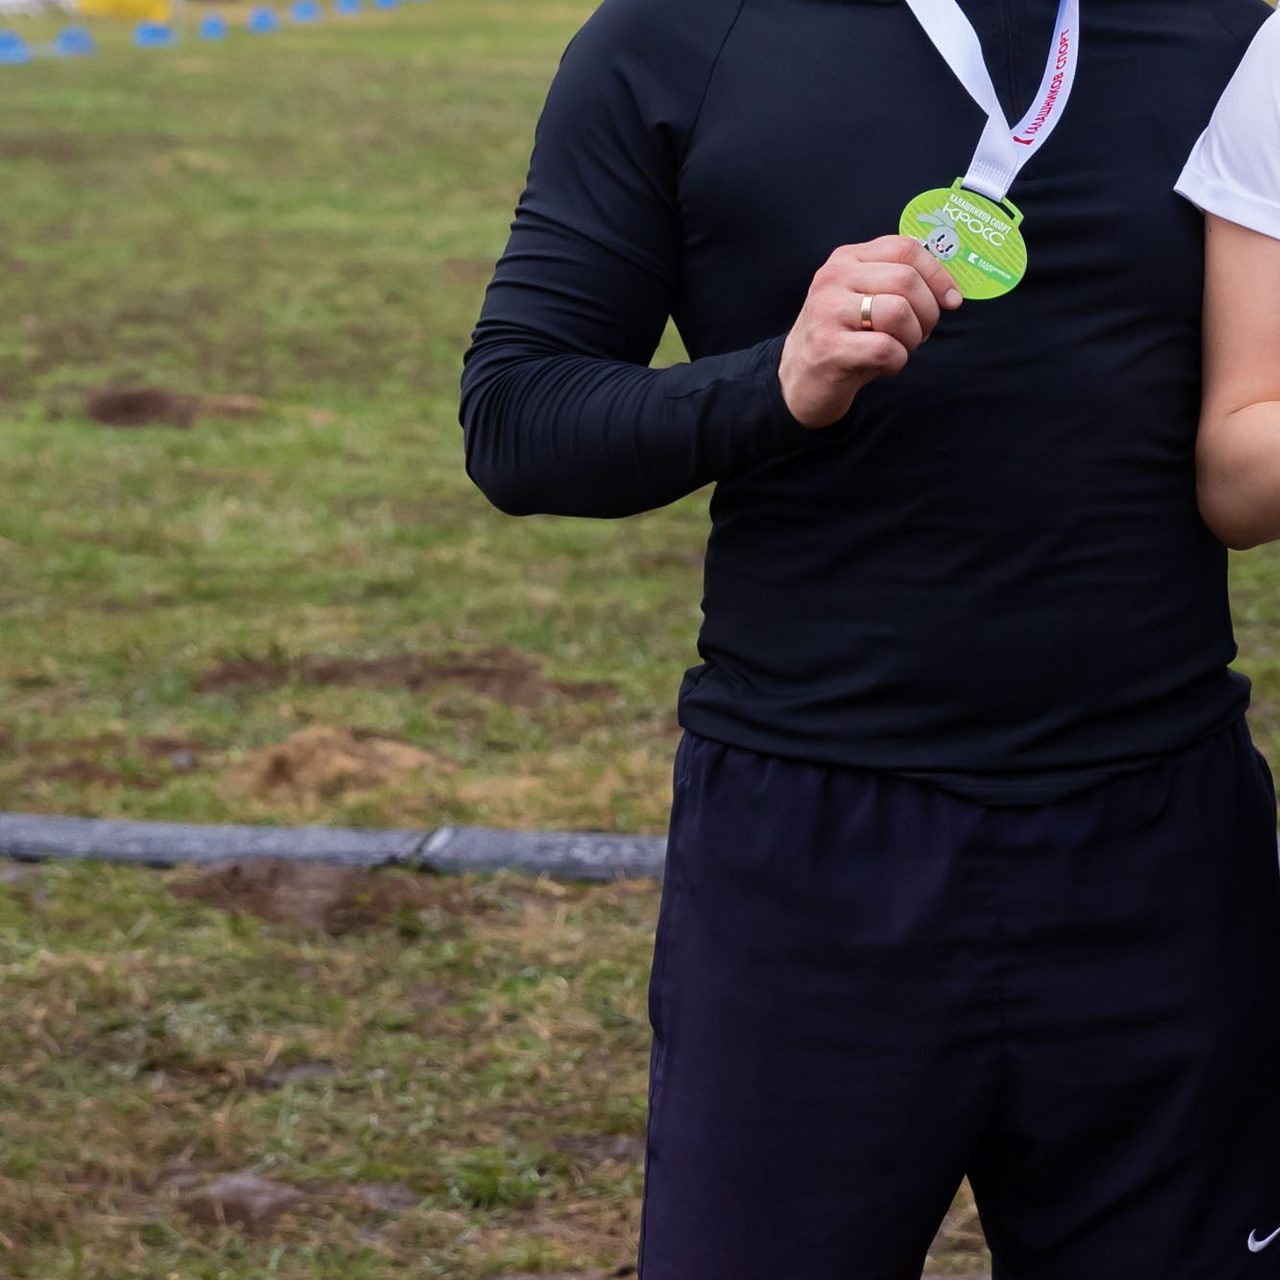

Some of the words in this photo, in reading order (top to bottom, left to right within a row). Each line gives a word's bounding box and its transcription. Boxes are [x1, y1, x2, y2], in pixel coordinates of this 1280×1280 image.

[1023, 72, 1064, 135] КАЛАШНИКОВ
[1055, 28, 1070, 70] СПОРТ
[942, 202, 1005, 247] КРОСС
[949, 193, 991, 223] КАЛАШНИКОВ
[990, 217, 1012, 234] СПОРТ
